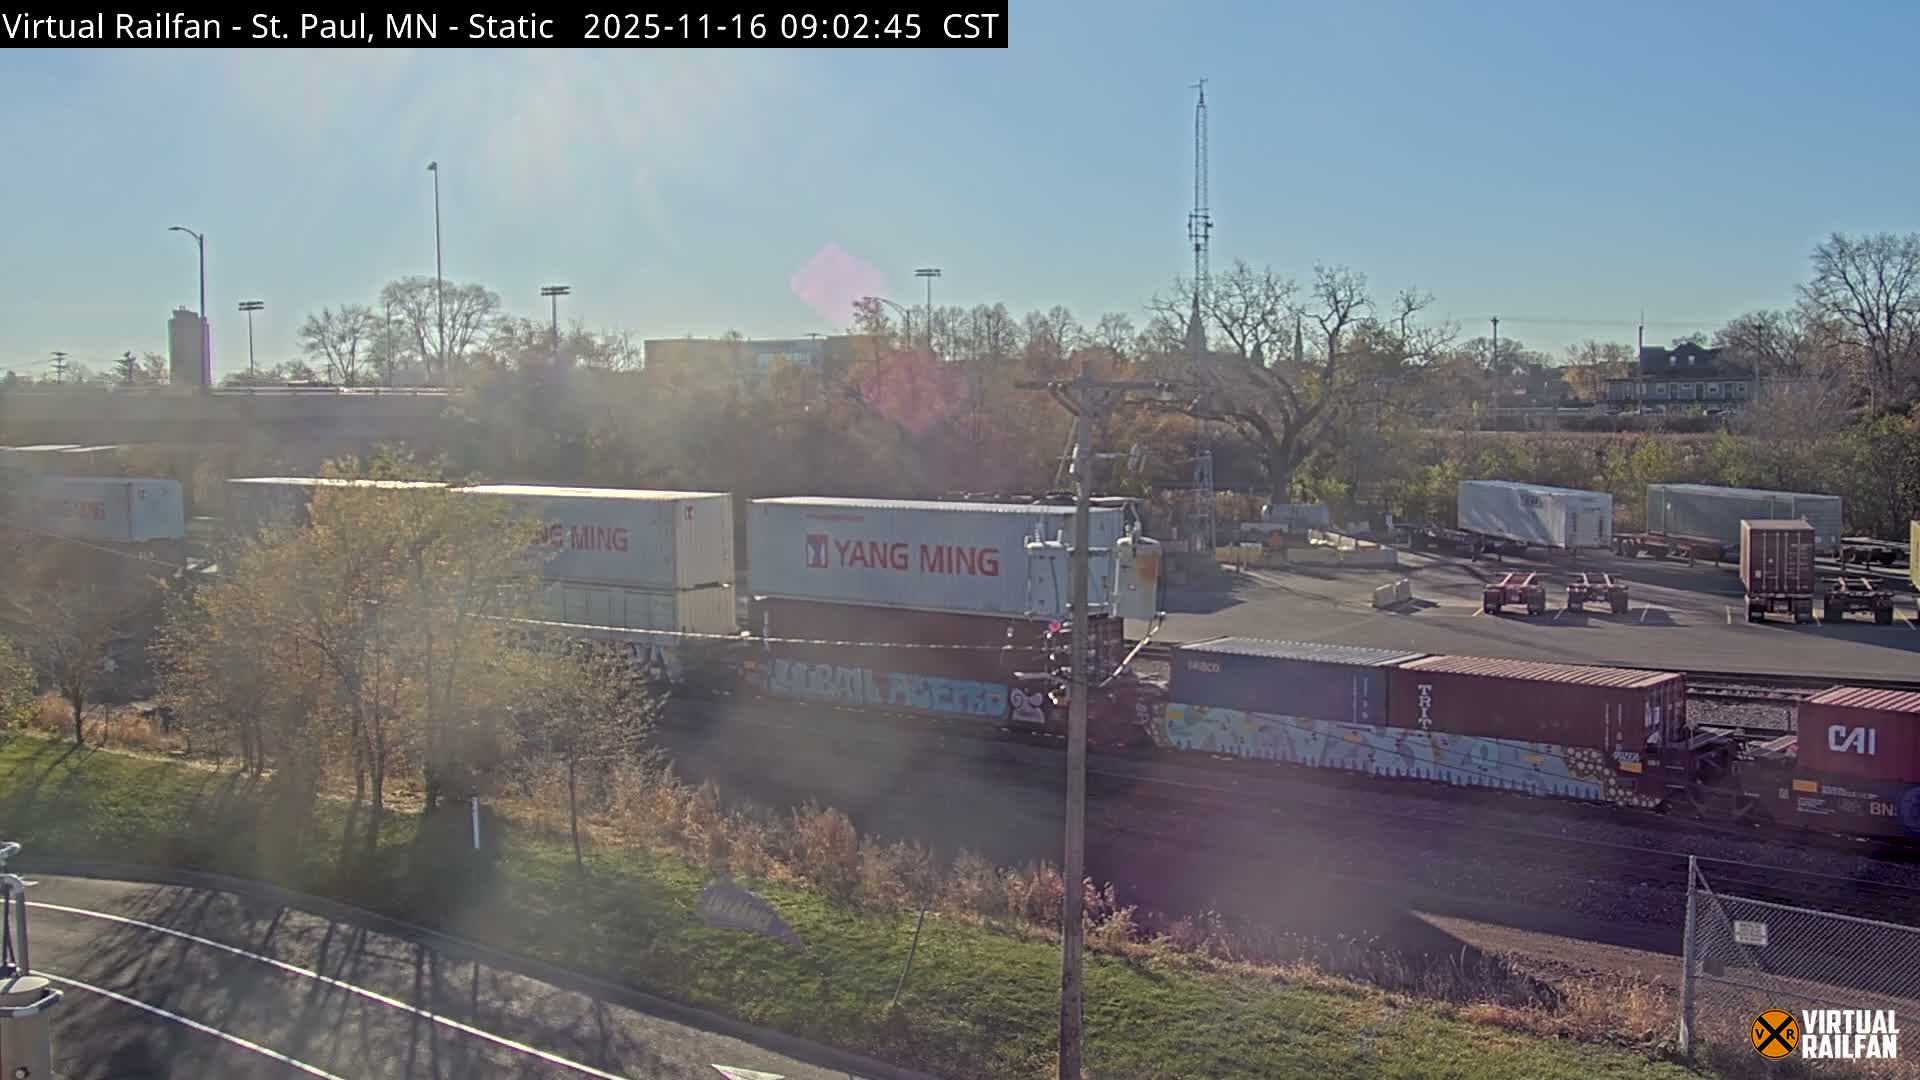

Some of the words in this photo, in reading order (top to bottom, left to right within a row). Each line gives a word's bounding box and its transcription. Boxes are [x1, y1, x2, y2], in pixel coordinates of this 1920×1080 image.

[571, 527, 629, 551] MING
[834, 540, 909, 570] YANG
[920, 544, 999, 577] MING
[1828, 724, 1876, 755] CAI
